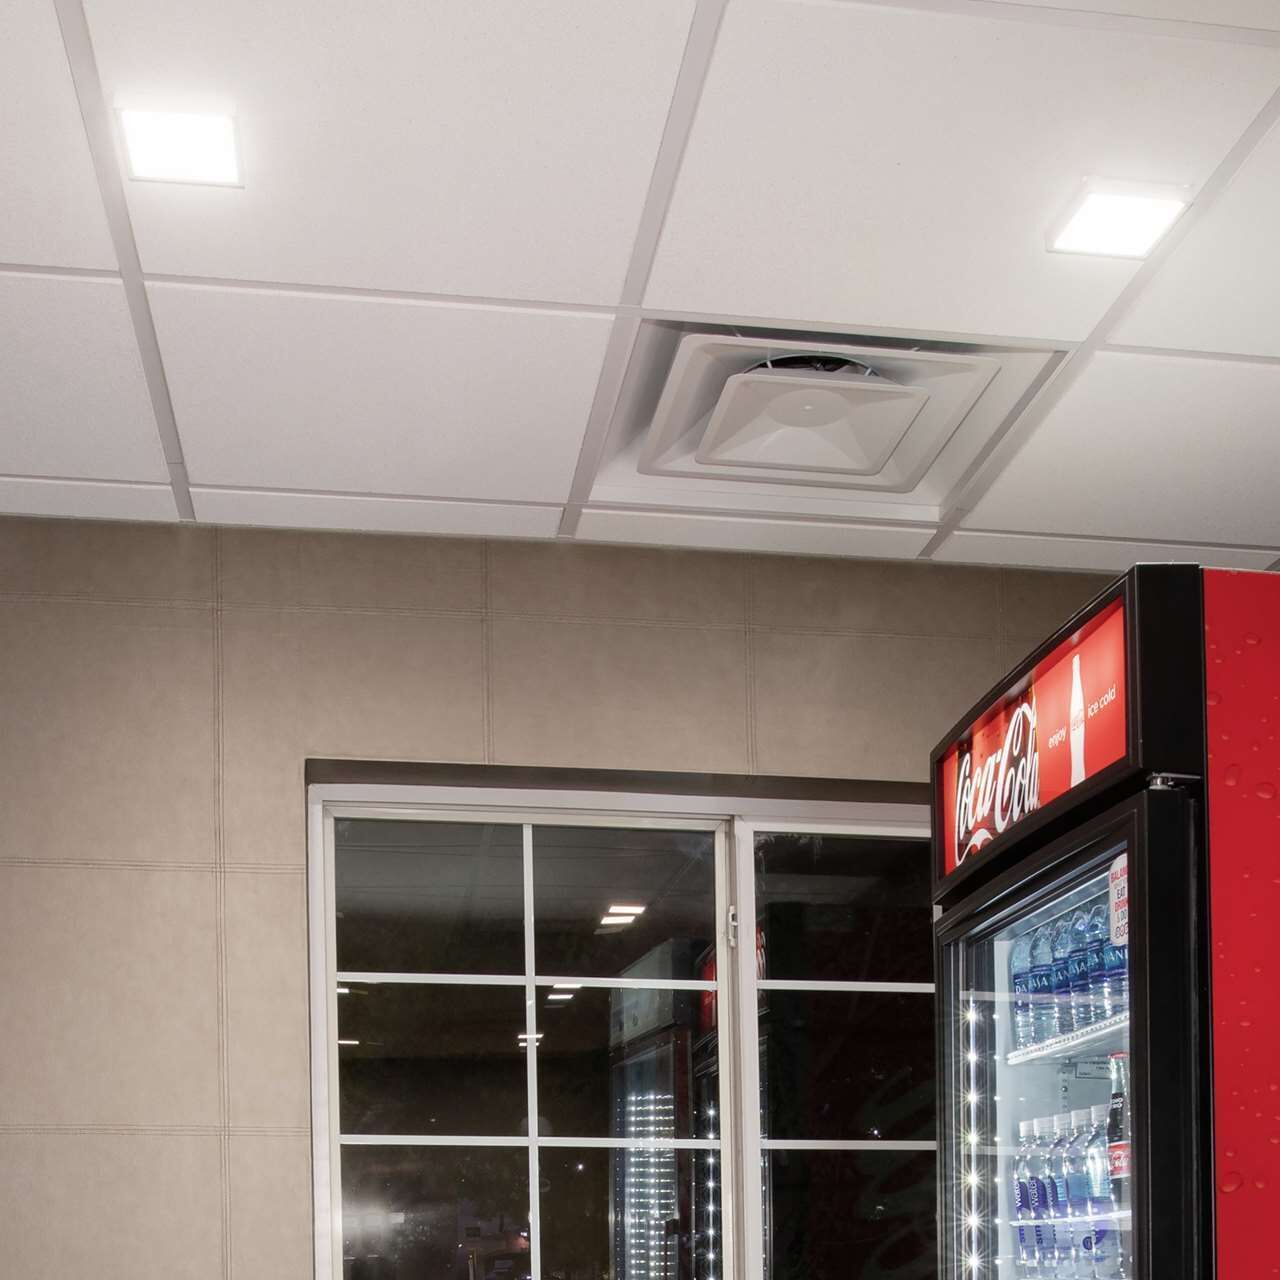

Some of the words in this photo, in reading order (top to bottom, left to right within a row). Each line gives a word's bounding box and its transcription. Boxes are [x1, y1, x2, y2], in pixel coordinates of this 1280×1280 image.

[1087, 702, 1100, 719] ice
[1099, 687, 1116, 713] cold
[1048, 725, 1067, 748] enjoy
[956, 696, 1040, 866] Coca-Cola
